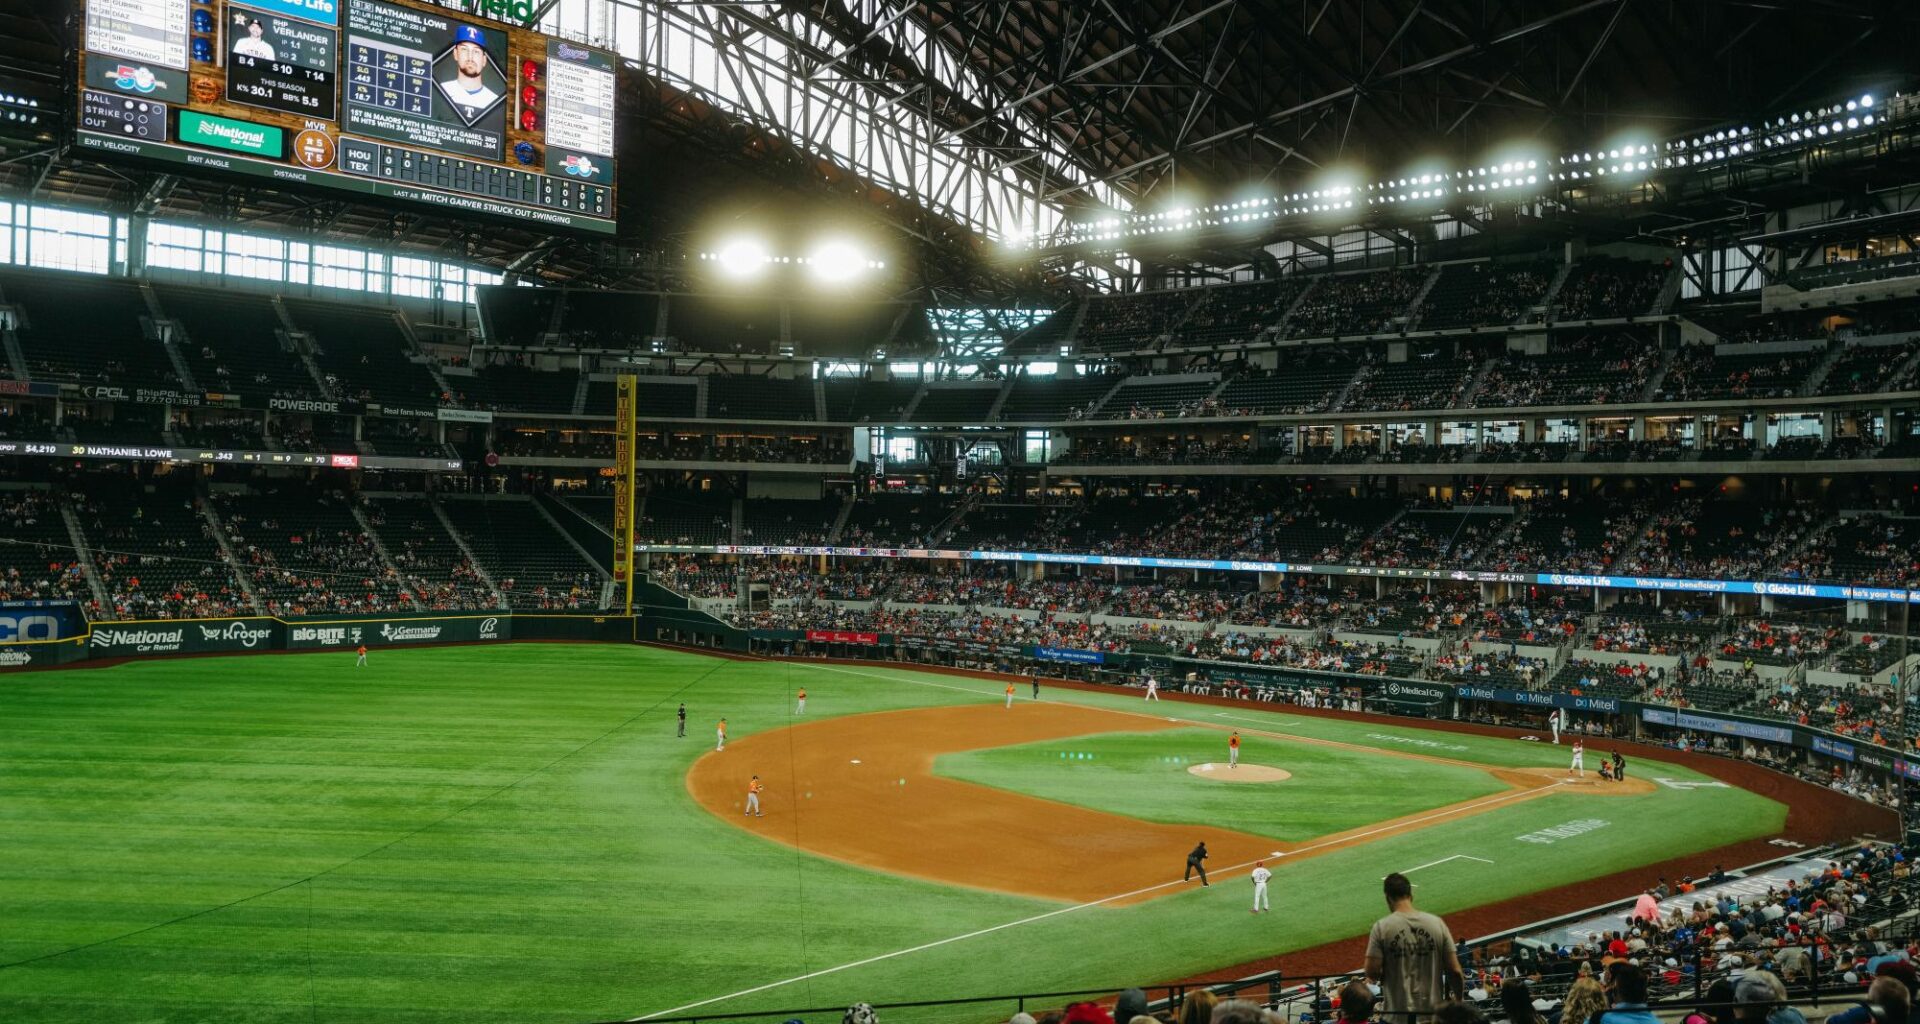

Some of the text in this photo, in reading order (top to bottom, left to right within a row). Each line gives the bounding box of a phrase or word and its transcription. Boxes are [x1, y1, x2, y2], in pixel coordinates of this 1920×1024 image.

[375, 6, 447, 31] NATHANIEL LOWE
[273, 26, 328, 45] VERLANDER
[386, 31, 413, 42] NORFOLK,
[111, 46, 161, 61] MALDONADO
[290, 41, 326, 55] 1.1 0
[359, 47, 368, 55] PA
[291, 53, 297, 61] 2
[239, 57, 325, 82] B 4 S 10 T 14
[383, 61, 399, 70] .343
[355, 74, 371, 83] .443
[261, 79, 306, 93] THIS SEASON
[85, 93, 111, 104] BALL
[236, 84, 319, 107] K% 30.1 BB% 5.5
[355, 93, 371, 102] 18.7
[384, 99, 396, 107] 6.7
[85, 105, 120, 118] STRIKE
[85, 118, 107, 128] OUT
[305, 120, 326, 132] MVR
[351, 109, 363, 117] 1ST
[373, 113, 401, 124] MAJORS
[403, 119, 420, 128] WITH
[427, 124, 458, 136] MULTI-HIT
[214, 124, 264, 143] National
[351, 115, 360, 123] IN
[361, 118, 376, 126] HITS
[377, 121, 395, 130] WITH
[406, 126, 421, 134] AND
[422, 129, 437, 137] TIED
[438, 132, 452, 141] FOR
[466, 138, 482, 147] WITH
[316, 138, 323, 147] 5
[84, 138, 307, 181] EXIT VELOCITY EXIT ANGLE DISTANCE
[316, 154, 322, 162] 5
[348, 148, 411, 168] HOU 0 0
[350, 161, 392, 176] TEX 0
[393, 190, 408, 198] LAST
[421, 193, 448, 203] MITCH
[449, 197, 482, 209] GARVER
[484, 202, 513, 214] STRUCK
[514, 208, 531, 217] OUT
[532, 212, 571, 224] SWINGING
[95, 387, 129, 399] PGL
[269, 399, 338, 413] POWERADE
[400, 408, 414, 416] fans
[415, 409, 435, 417] know.
[25, 444, 56, 454] $4,210
[72, 446, 85, 454] 30
[87, 447, 142, 457] NATHANIEL
[145, 449, 172, 458] LOWE
[215, 452, 233, 460] .343
[618, 440, 627, 475] HOT
[1242, 562, 1276, 571] Globe Life
[1500, 574, 1525, 582] $4,210
[1563, 576, 1611, 586] Globe Life
[1635, 579, 1659, 587] Who's
[1660, 581, 1678, 590] your
[1768, 584, 1816, 596] Globe Life
[1869, 590, 1888, 600] your
[223, 622, 272, 647] Kroger
[317, 628, 346, 640] BITE
[398, 625, 442, 635] Germania
[112, 629, 183, 645] National
[153, 643, 179, 651] Rental
[1401, 686, 1444, 699] Medical City
[1471, 688, 1495, 699] Mitel
[1529, 693, 1553, 704] Mitel
[1589, 699, 1615, 710] Mitel
